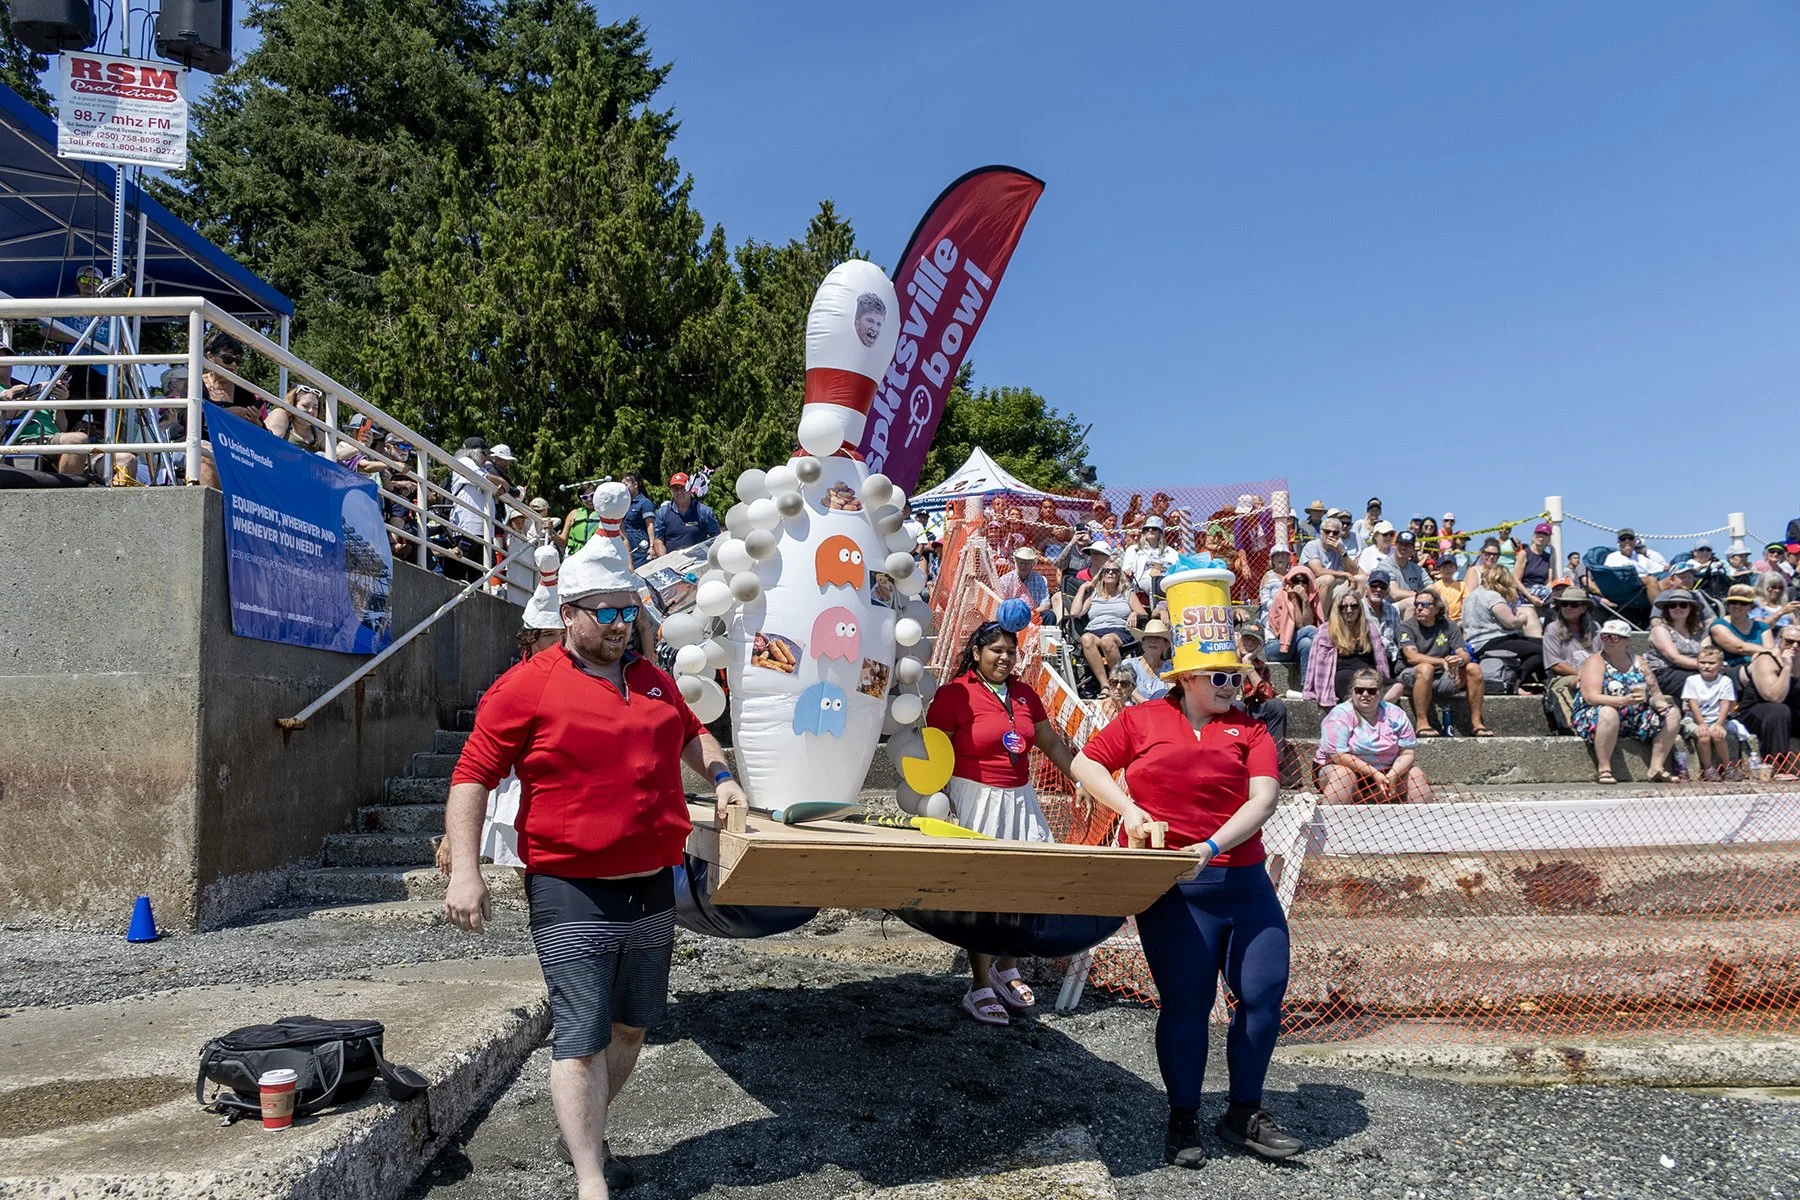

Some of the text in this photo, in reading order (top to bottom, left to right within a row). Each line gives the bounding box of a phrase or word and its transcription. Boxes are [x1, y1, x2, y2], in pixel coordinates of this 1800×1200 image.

[71, 57, 178, 90] RSM
[74, 80, 177, 101] Productions
[74, 109, 170, 129] 98.7 mhz FM
[73, 128, 94, 137] Call:
[97, 131, 119, 141] (250)
[122, 134, 161, 144] 758-8095
[86, 139, 108, 148] Free:
[112, 142, 176, 155] 1-800-451-0277
[921, 258, 993, 389] bowl
[868, 238, 959, 475] splitsville
[228, 437, 273, 469] United Rentals
[231, 494, 336, 544] EQUIPMENT, WHEREVER AND
[232, 516, 324, 558] WHENEVER YOU NEED IT.
